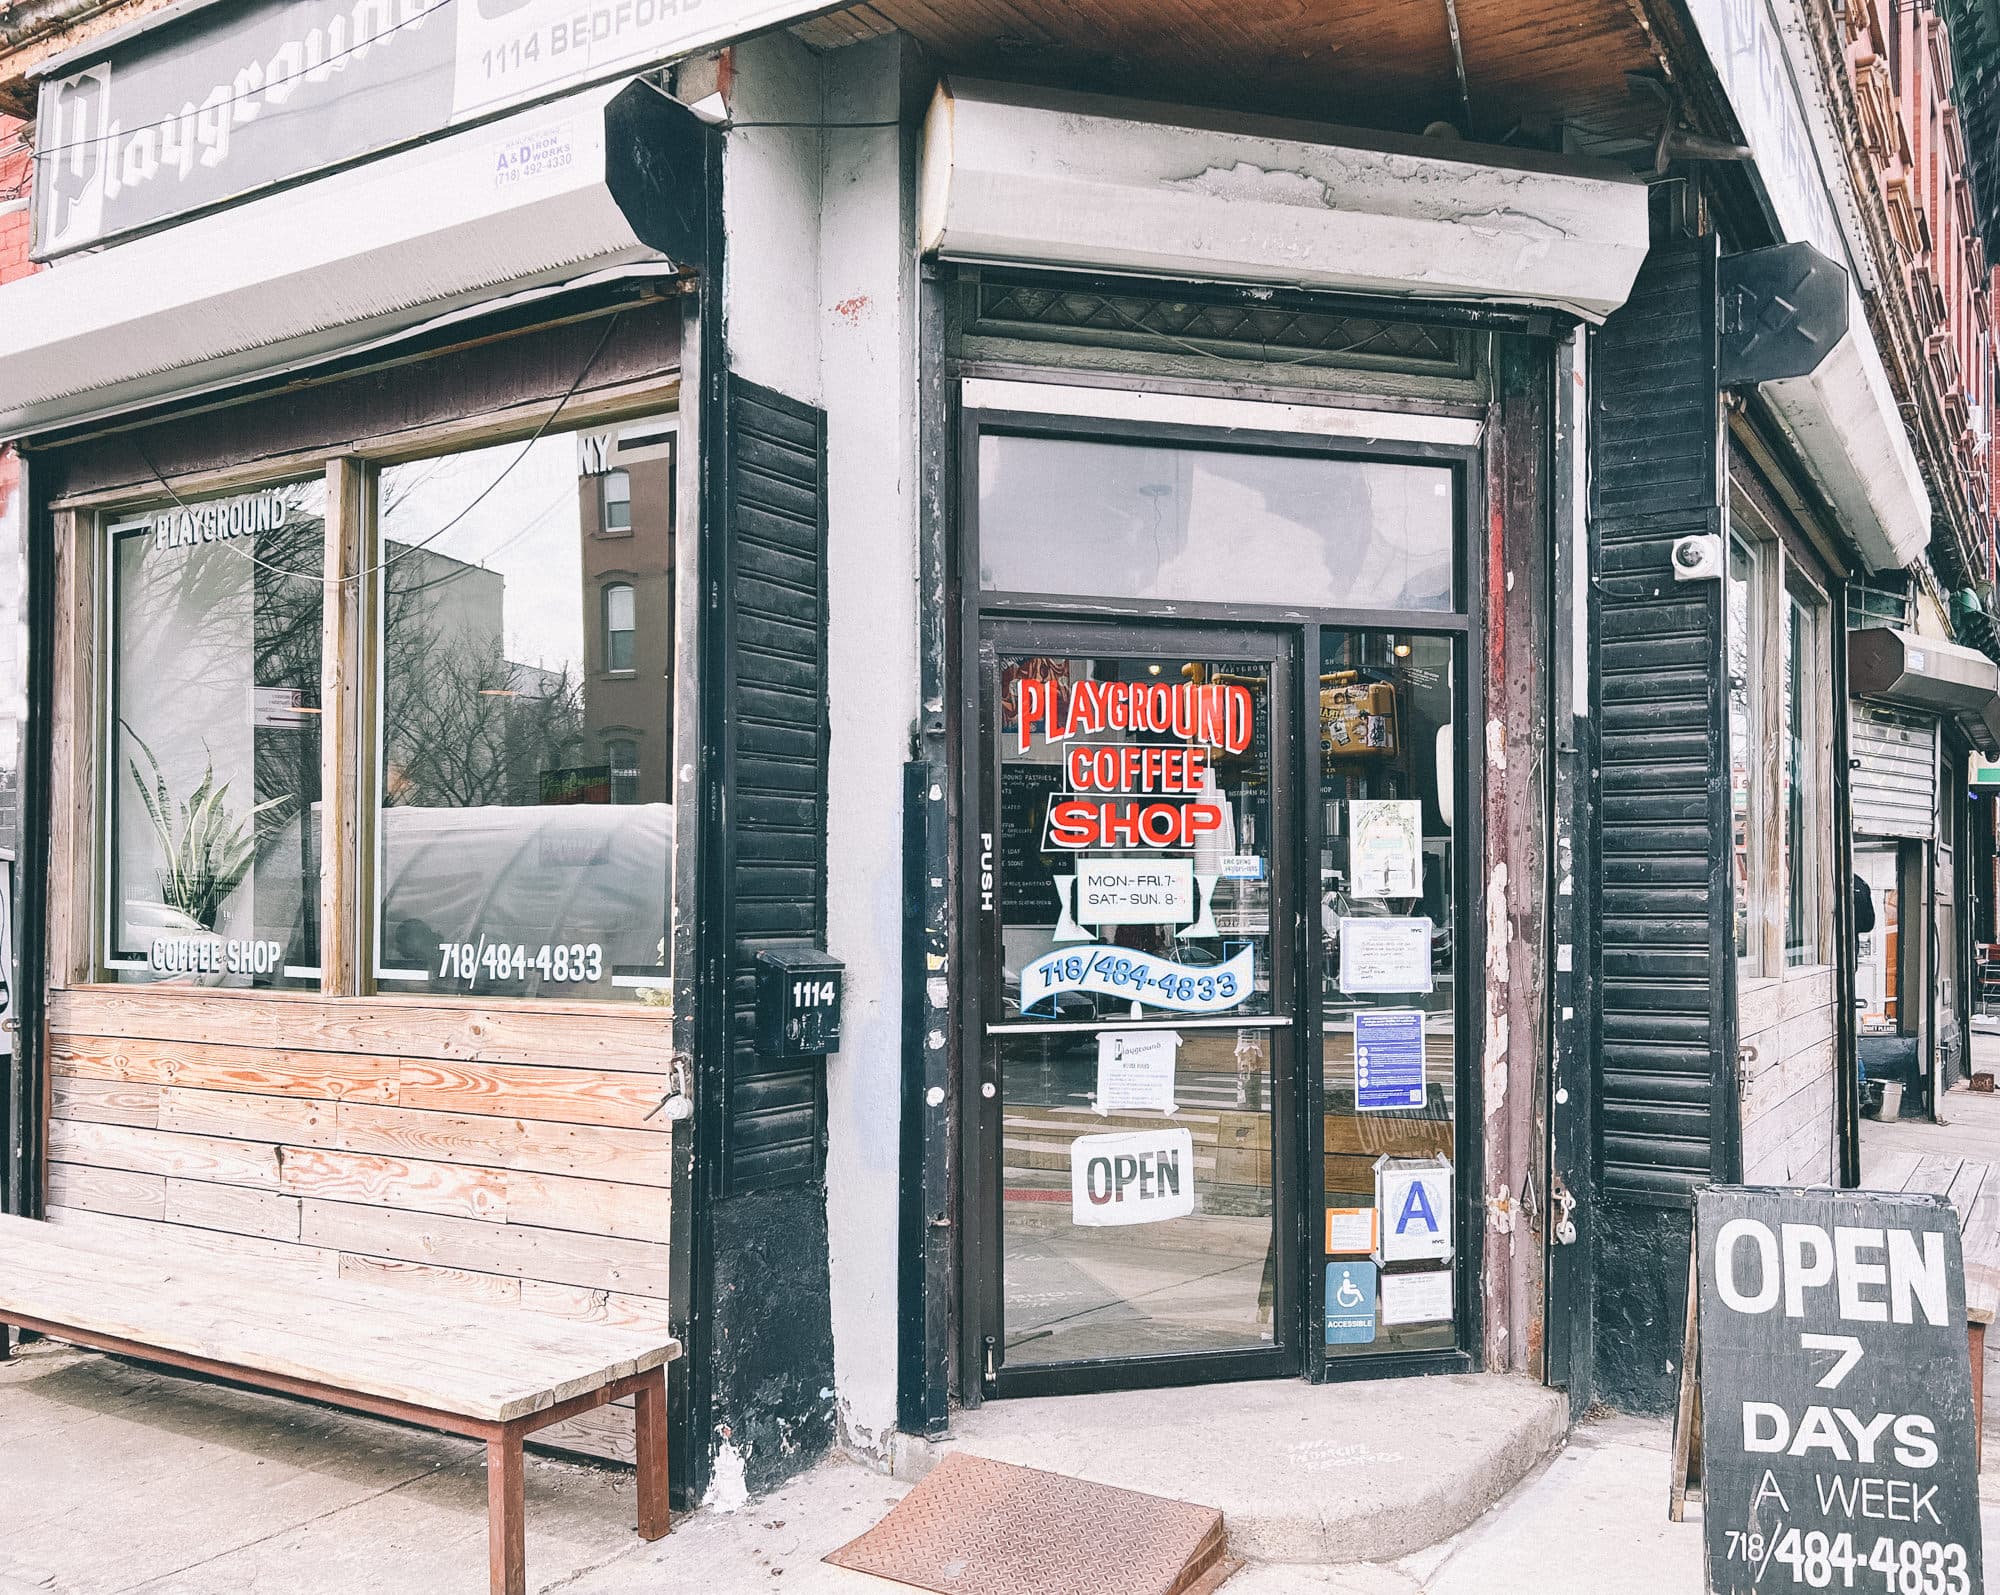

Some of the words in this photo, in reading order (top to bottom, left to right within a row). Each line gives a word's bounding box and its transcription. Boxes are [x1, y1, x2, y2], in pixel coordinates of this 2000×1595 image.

[480, 30, 540, 80] 1114
[533, 143, 570, 161] WORKS
[155, 496, 287, 549] PLAYGROUND
[1017, 678, 1253, 755] PLAYGROUND
[1067, 746, 1205, 792] COFFEE
[1048, 800, 1223, 850] SHOP
[980, 832, 993, 911] PUSH
[151, 938, 222, 973] COFFEE
[225, 939, 282, 974] SHOP
[438, 932, 603, 990] 718/484-4833
[1039, 950, 1238, 1000] 718/484-4833
[793, 981, 836, 1008] 1114
[1086, 1149, 1180, 1206] OPEN
[1395, 1180, 1440, 1235] A
[1714, 1218, 1950, 1327] OPEN
[1327, 1319, 1373, 1329] ACCESSIBLE
[1800, 1332, 1865, 1390] 7
[1742, 1401, 1939, 1469] DAYS
[1754, 1468, 1791, 1514] A
[1815, 1473, 1943, 1525] WEEK
[1724, 1521, 1971, 1595] 718/484-4833
